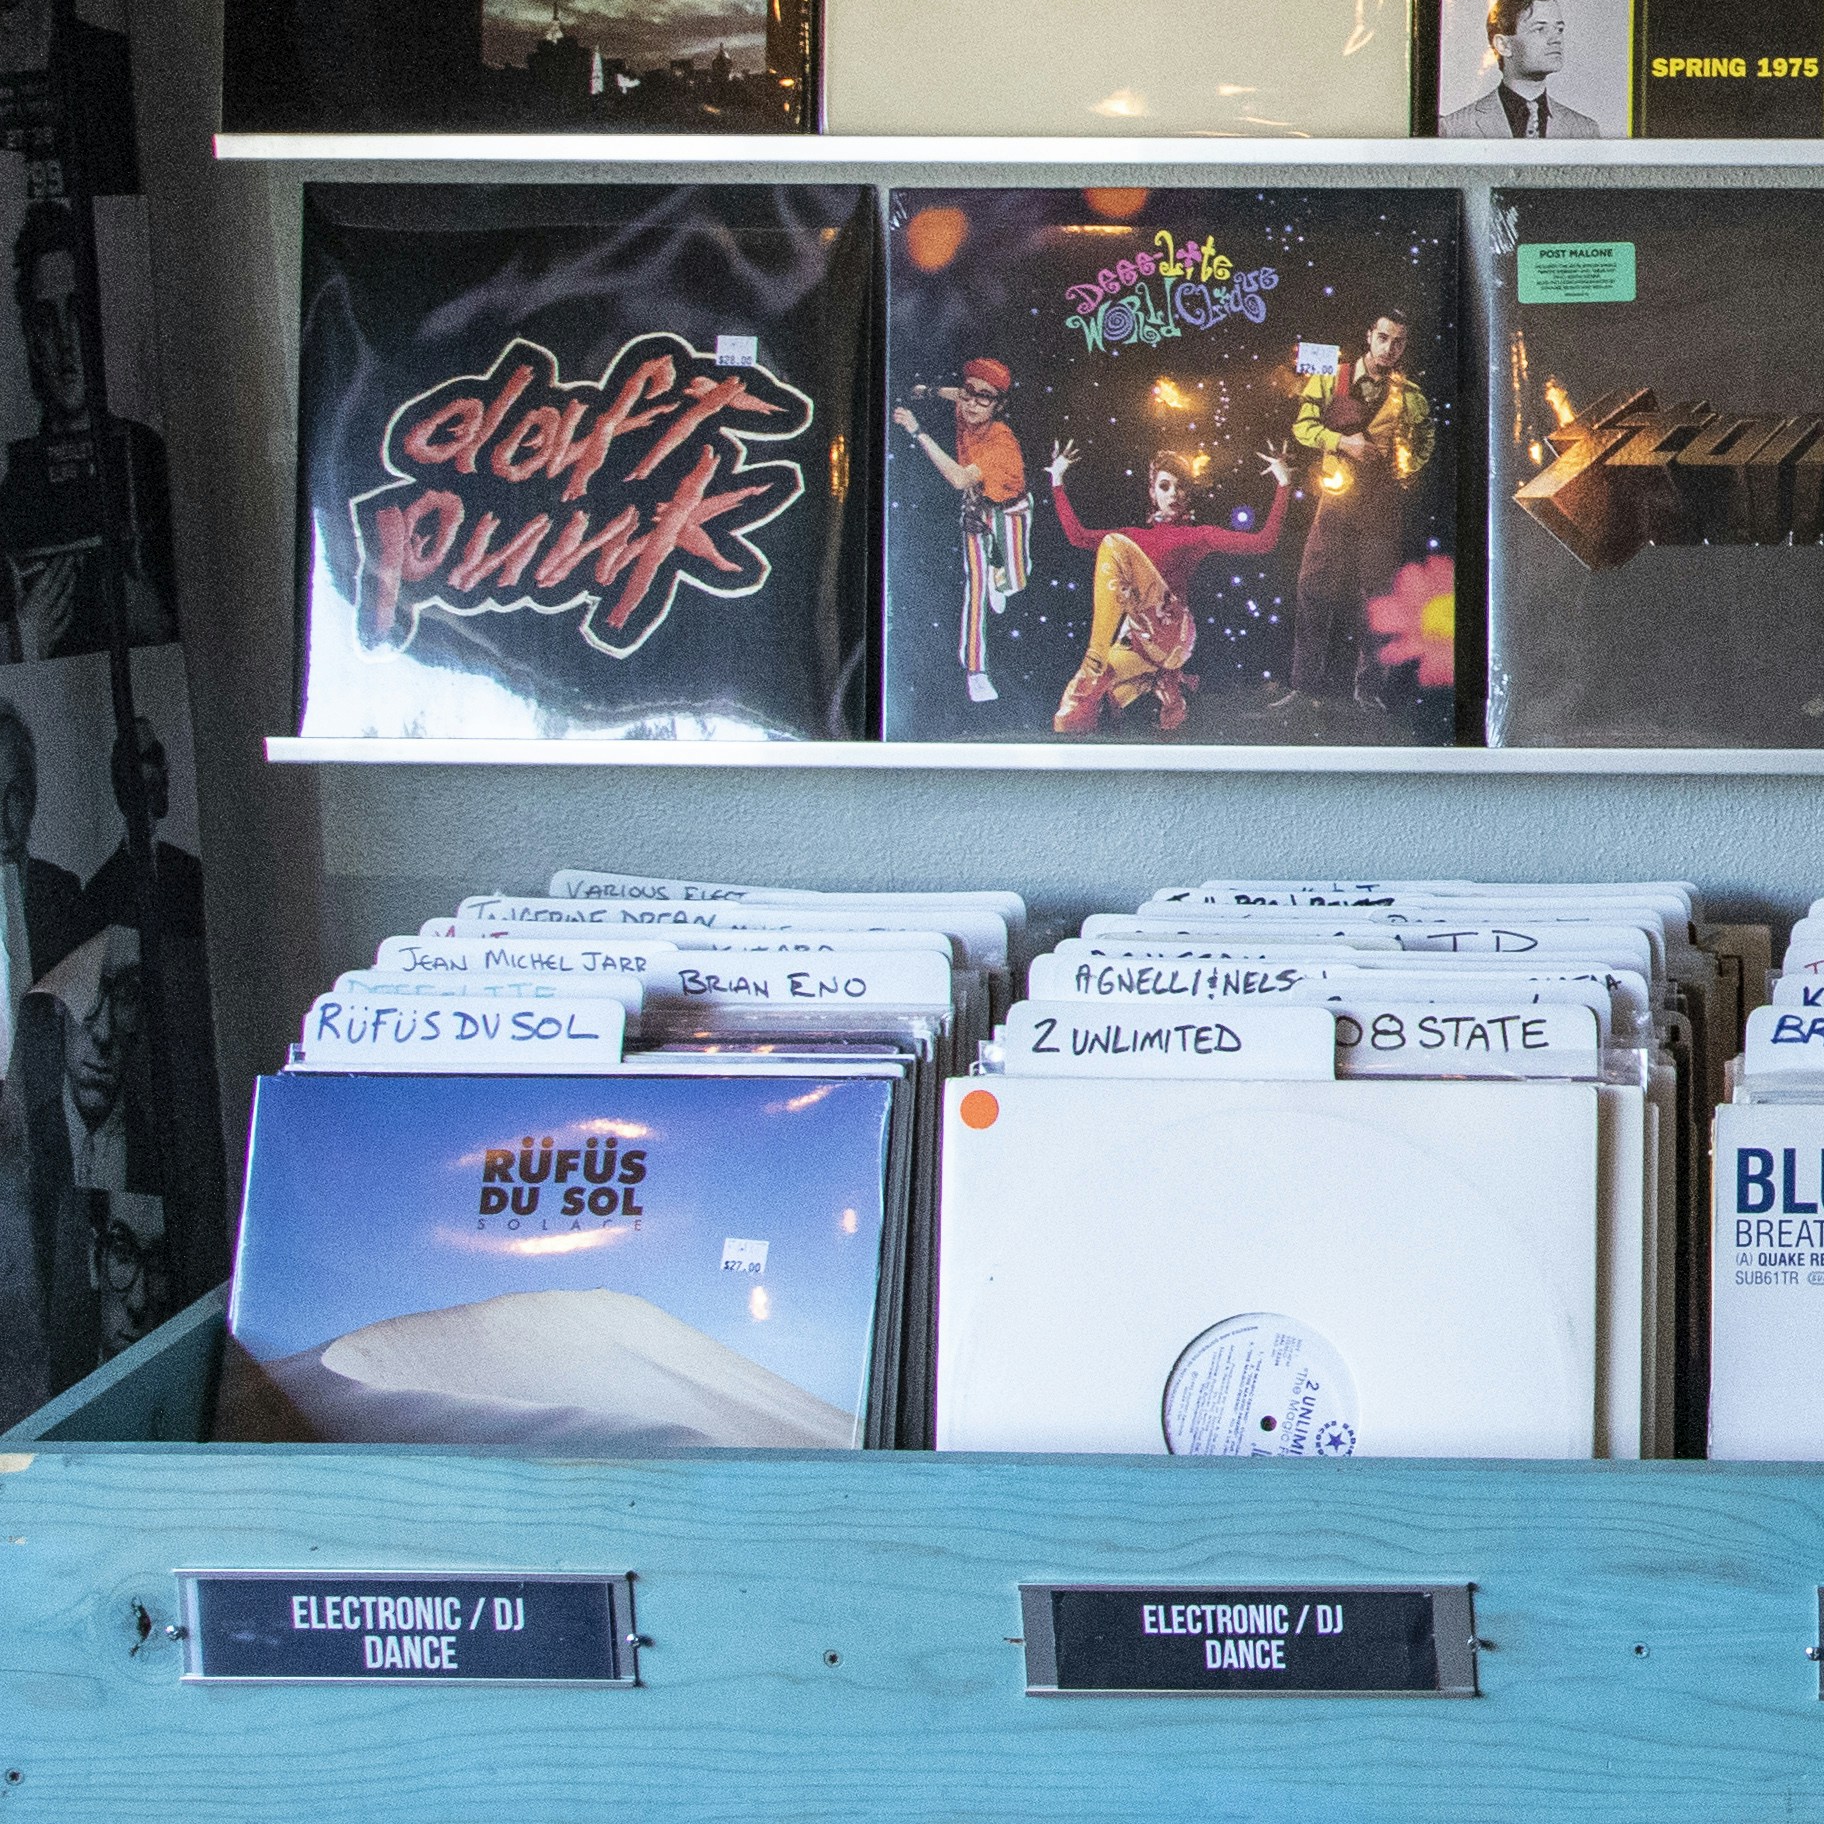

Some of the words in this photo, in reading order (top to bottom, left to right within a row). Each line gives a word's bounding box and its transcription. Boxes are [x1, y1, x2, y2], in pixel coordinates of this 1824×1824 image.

[1651, 57, 1747, 78] SPRING
[1756, 57, 1820, 78] 1975
[1539, 248, 1567, 259] POST
[1569, 248, 1614, 259] MALONE
[405, 355, 789, 502] daft
[376, 445, 773, 631] punk
[677, 969, 770, 999] BRIAN
[787, 970, 867, 999] ENO
[1071, 1023, 1242, 1057] UNLIMITED
[482, 1136, 648, 1184] RÜFÜS
[479, 1188, 540, 1217] DU
[561, 1187, 643, 1217] SOL
[1758, 1253, 1806, 1268] QUAKE
[291, 1595, 462, 1631] ELECTRONIC
[494, 1597, 525, 1632] DJ
[1141, 1604, 1289, 1635] ELECTRONIC
[1316, 1604, 1344, 1635] DJ
[364, 1635, 459, 1670] DANCE
[1204, 1639, 1287, 1670] DANCE
